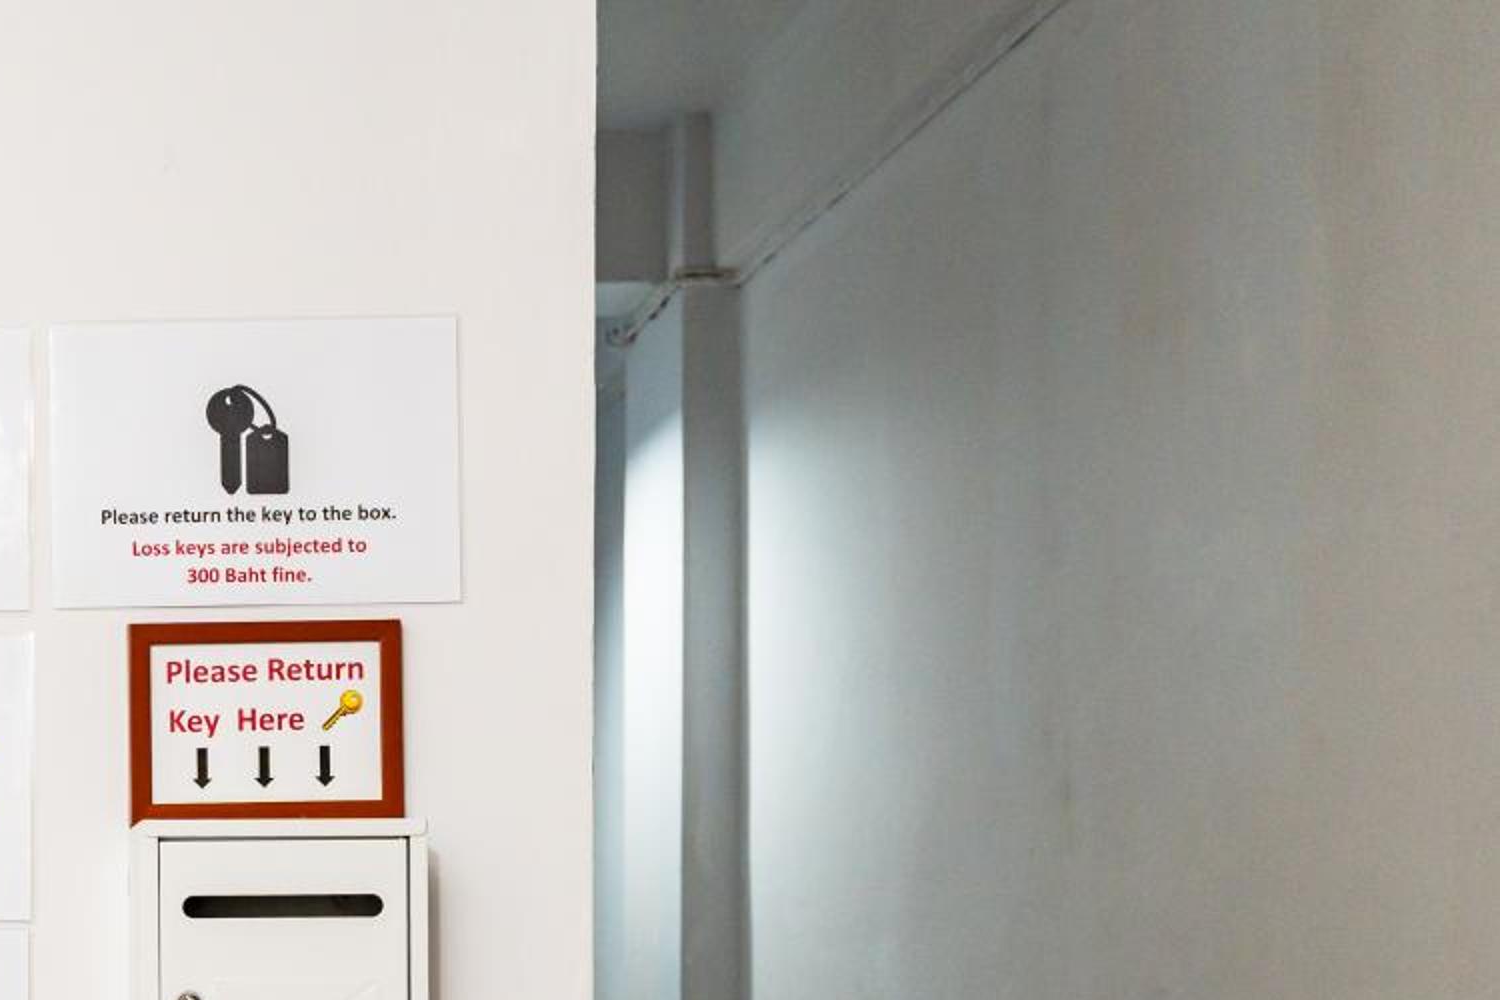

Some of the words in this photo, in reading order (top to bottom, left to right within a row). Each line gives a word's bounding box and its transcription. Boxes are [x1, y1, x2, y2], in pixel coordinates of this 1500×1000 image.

[102, 509, 159, 524] Please
[165, 510, 221, 523] return
[226, 507, 256, 522] the
[262, 506, 292, 525] key
[298, 508, 316, 521] to
[322, 506, 352, 521] the
[358, 505, 396, 520] box.
[132, 541, 170, 556] Loss
[175, 540, 215, 558] keys
[221, 543, 249, 555] are
[255, 538, 342, 557] subjected
[348, 539, 366, 552] to
[188, 568, 220, 583] 300
[226, 567, 266, 583] Baht
[272, 566, 311, 582] fine.
[167, 659, 257, 684] Please
[268, 659, 364, 681] Return
[170, 710, 220, 738] Key
[238, 708, 304, 731] Here
